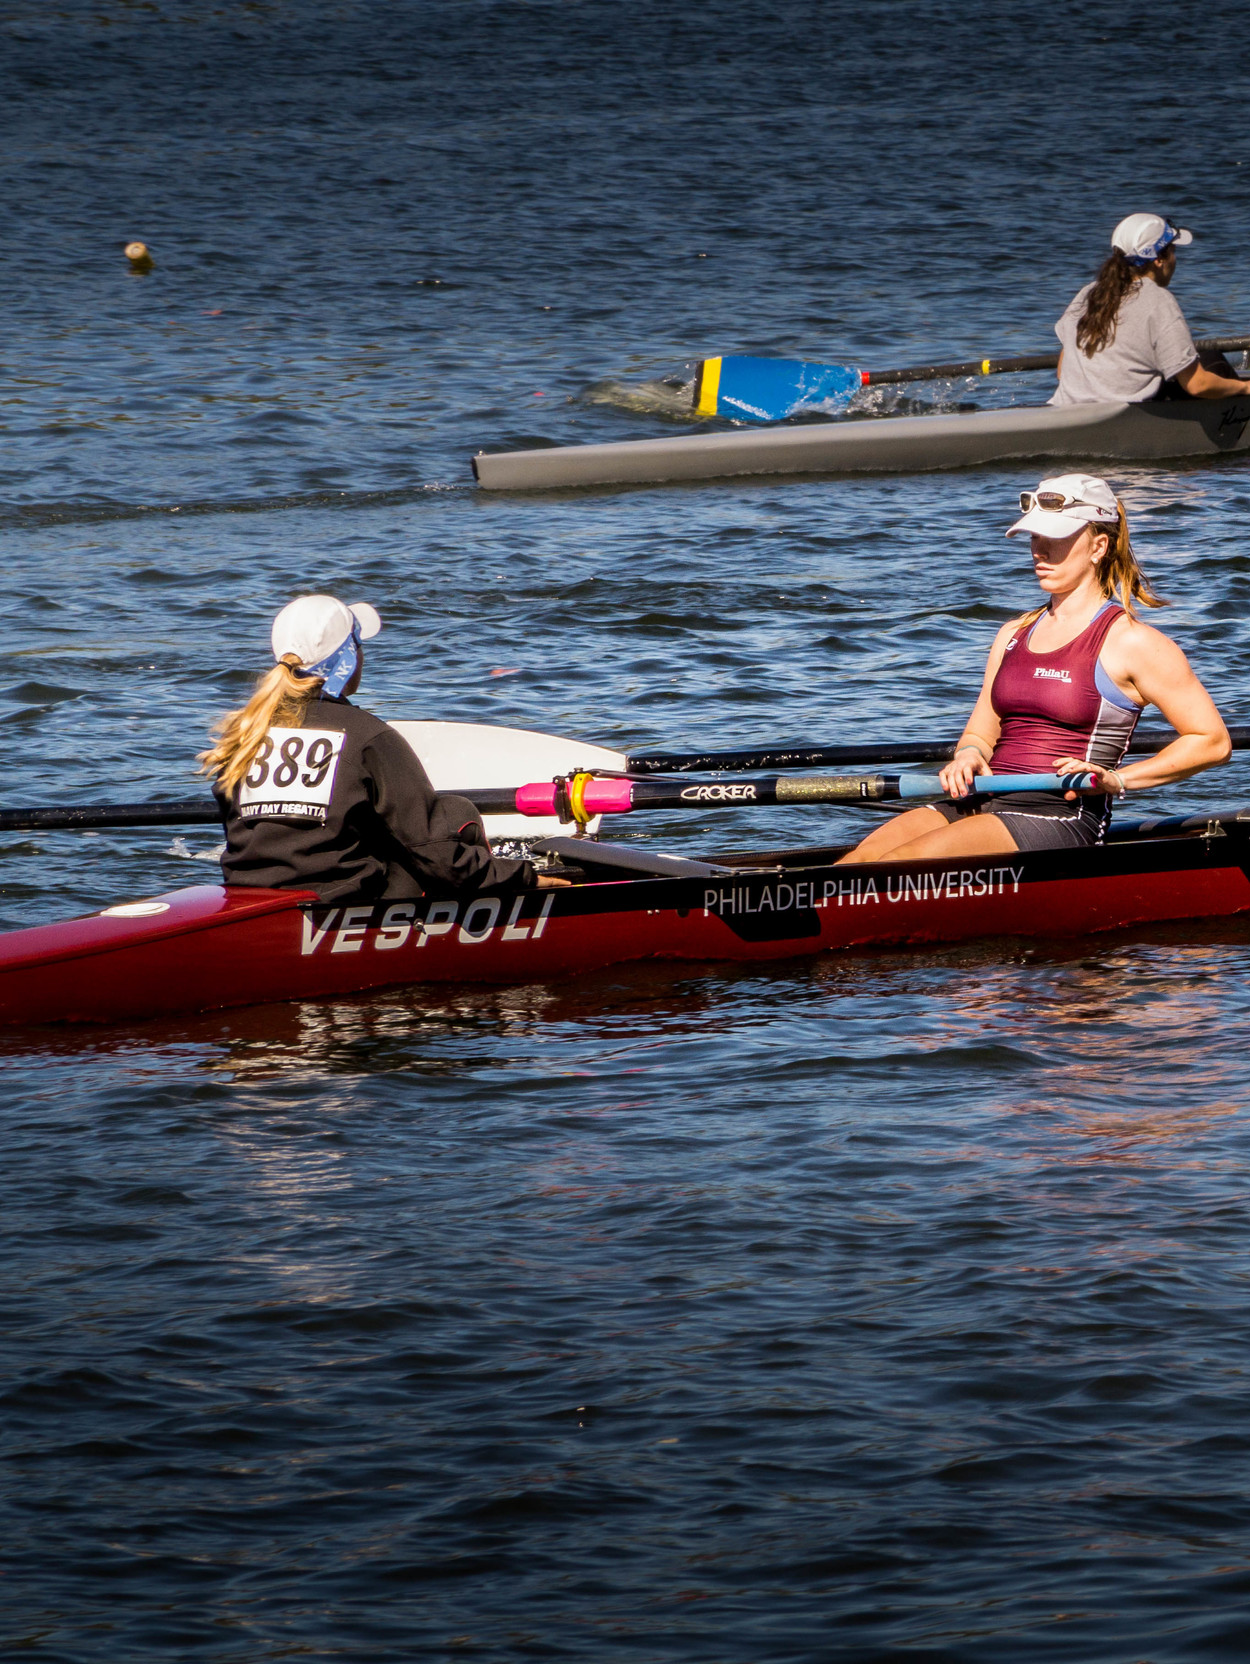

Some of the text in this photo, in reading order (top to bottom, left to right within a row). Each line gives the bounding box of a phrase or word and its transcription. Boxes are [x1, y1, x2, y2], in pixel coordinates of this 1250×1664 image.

[1033, 667, 1070, 679] PhilaU
[246, 735, 333, 789] 389
[680, 784, 757, 801] CROKER
[260, 803, 281, 814] DAY
[281, 803, 327, 818] REGATTA
[703, 866, 1025, 917] PHILADELPHIA UNIVERSITY
[301, 893, 556, 955] VESPOLI
